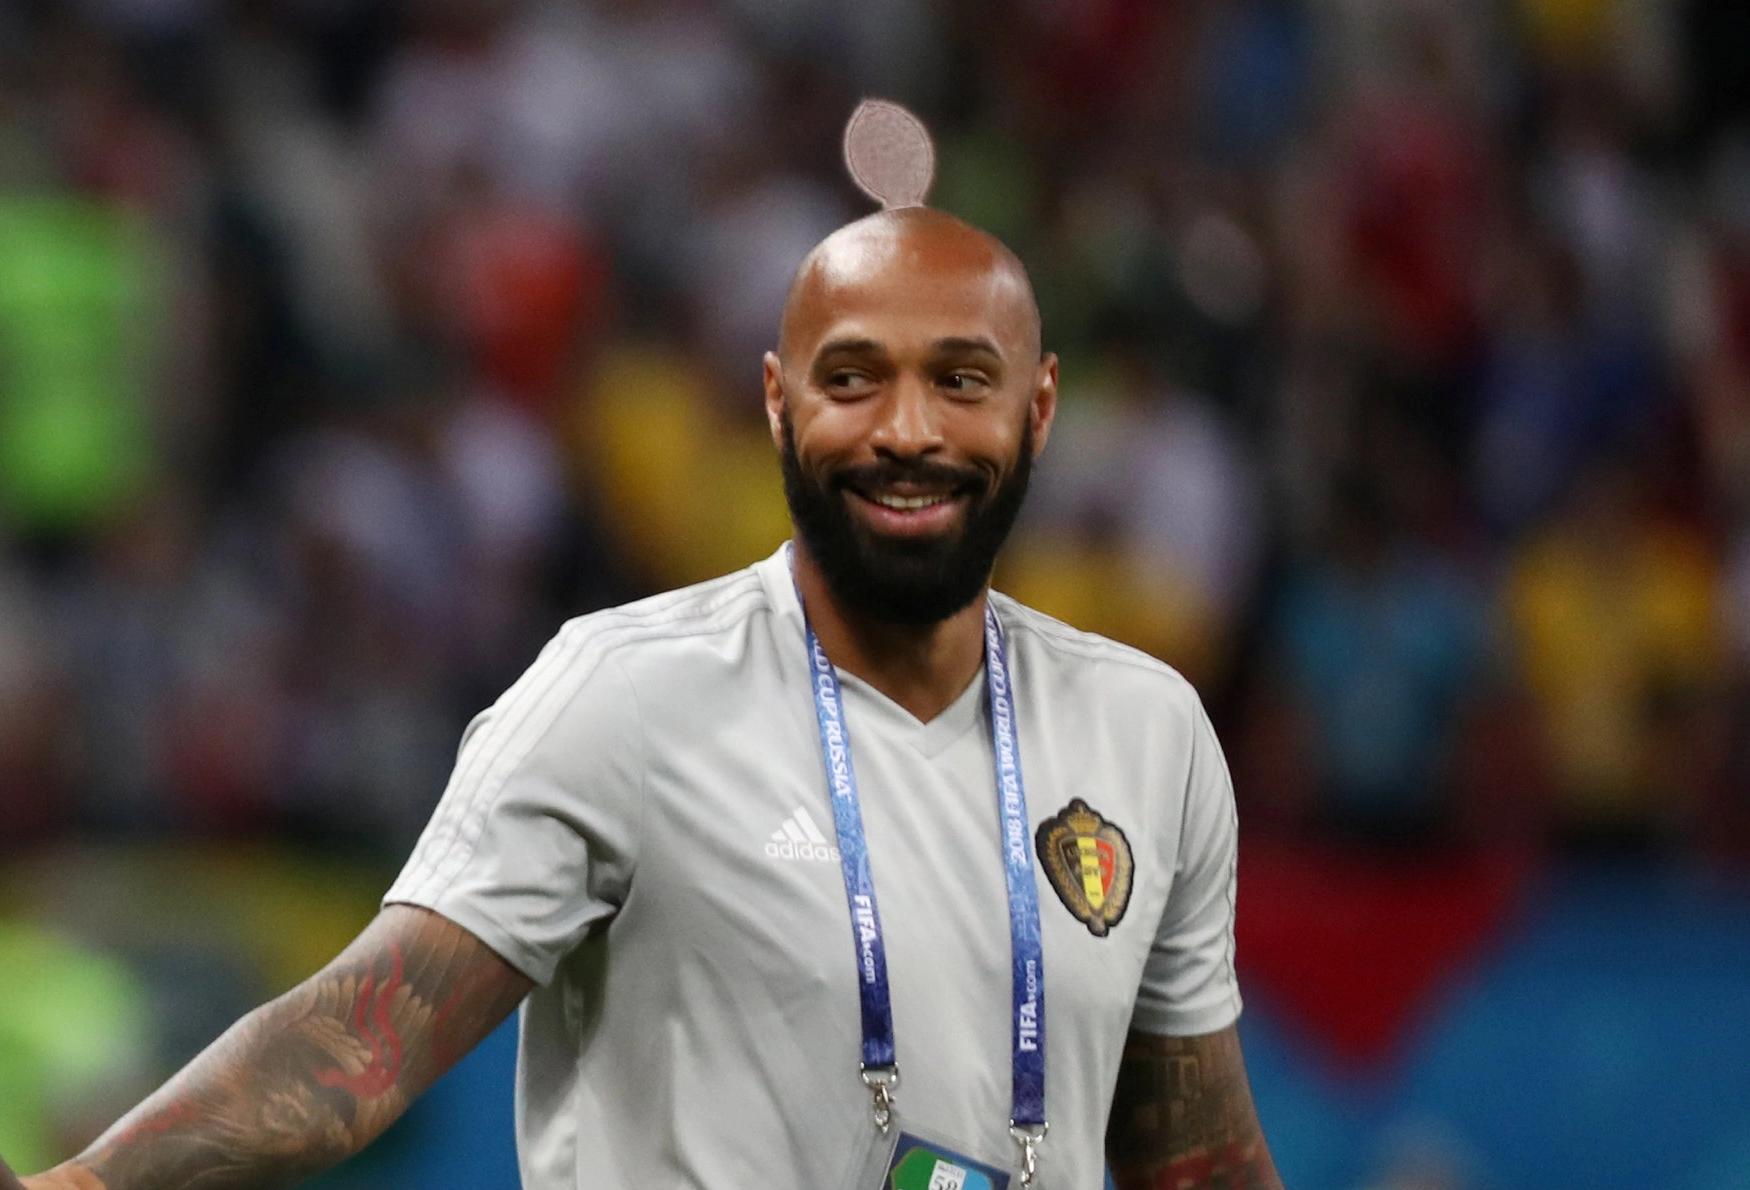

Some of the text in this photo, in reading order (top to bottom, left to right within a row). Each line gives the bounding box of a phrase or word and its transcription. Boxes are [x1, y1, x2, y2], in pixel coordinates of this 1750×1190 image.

[818, 674, 838, 716] CUP
[825, 720, 851, 799] RUSSIA
[995, 697, 1017, 772] WORLD
[765, 840, 841, 861] adidas
[854, 894, 876, 984] FIFA.com
[1019, 960, 1037, 1050] FIFA.com
